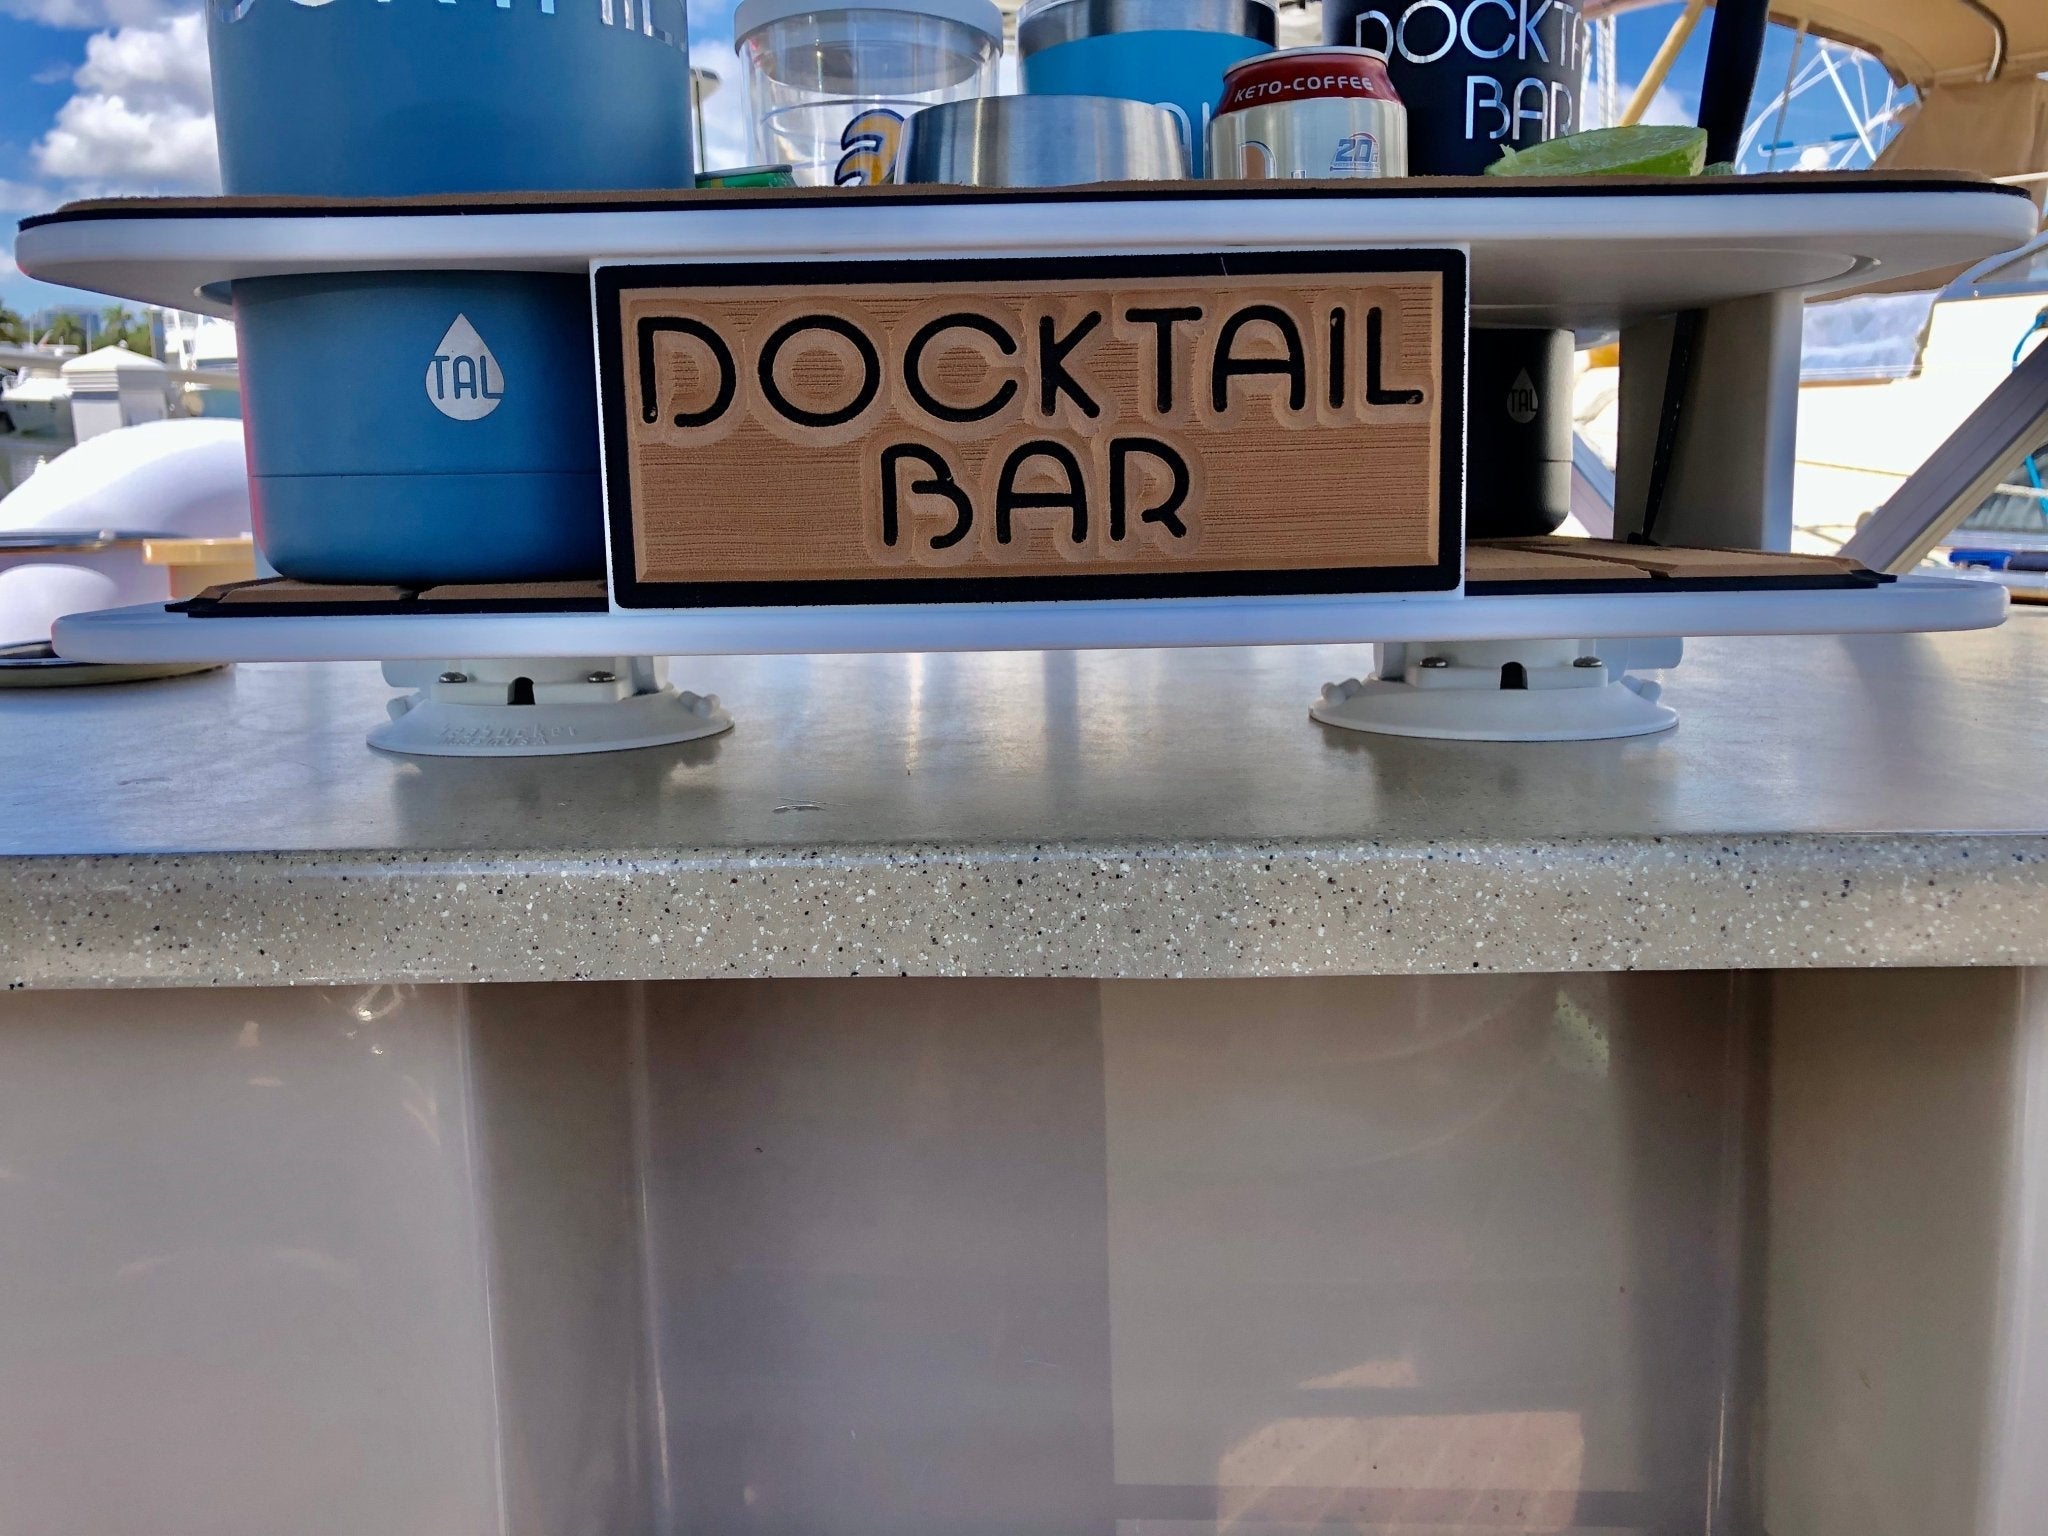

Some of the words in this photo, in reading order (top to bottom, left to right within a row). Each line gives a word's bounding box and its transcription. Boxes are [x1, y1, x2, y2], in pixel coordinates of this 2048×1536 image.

[1234, 75, 1374, 102] KETO-COFFEE
[1465, 75, 1573, 142] BAR
[431, 355, 504, 399] TAL
[637, 304, 1425, 429] DOCKTAIL
[1510, 388, 1538, 412] TAL
[880, 437, 1190, 550] BAR
